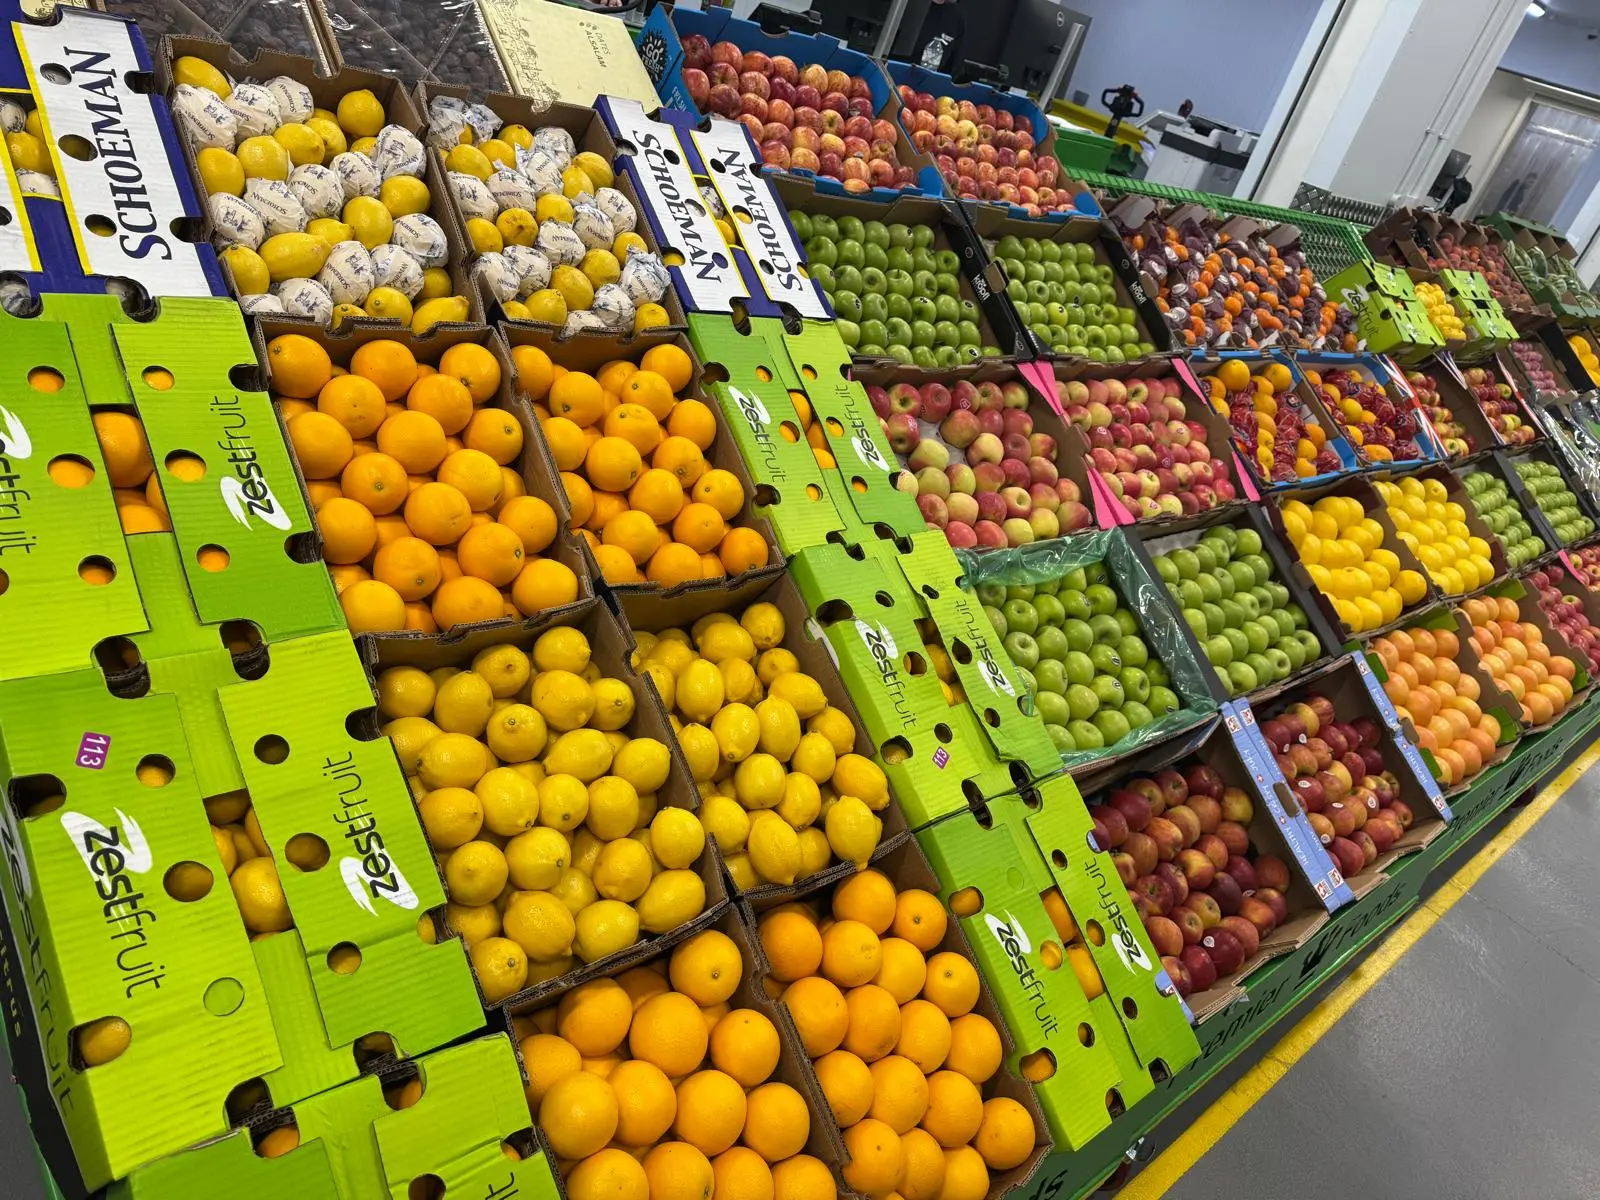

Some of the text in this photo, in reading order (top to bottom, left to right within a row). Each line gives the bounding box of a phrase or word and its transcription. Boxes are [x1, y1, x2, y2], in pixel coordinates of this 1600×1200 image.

[645, 43, 660, 63] GO
[63, 46, 173, 260] SCHOEMAN
[250, 191, 287, 215] SCHOEMAN
[632, 129, 722, 283] SCHOEMAN
[717, 146, 803, 291] SCHOEMAN
[210, 395, 275, 516] zestfruit
[739, 397, 786, 483] zestfruit
[836, 384, 880, 462] zestfruit
[865, 630, 917, 730] zestfruit
[955, 599, 1006, 689] zestfruit
[80, 735, 107, 768] 113
[933, 749, 949, 766] 113
[323, 750, 400, 899] zestfruit
[1284, 822, 1309, 865] HEALTHY
[83, 826, 166, 999] zestfruit
[1084, 857, 1141, 963] zestfruit
[996, 922, 1058, 1040] zestfruit
